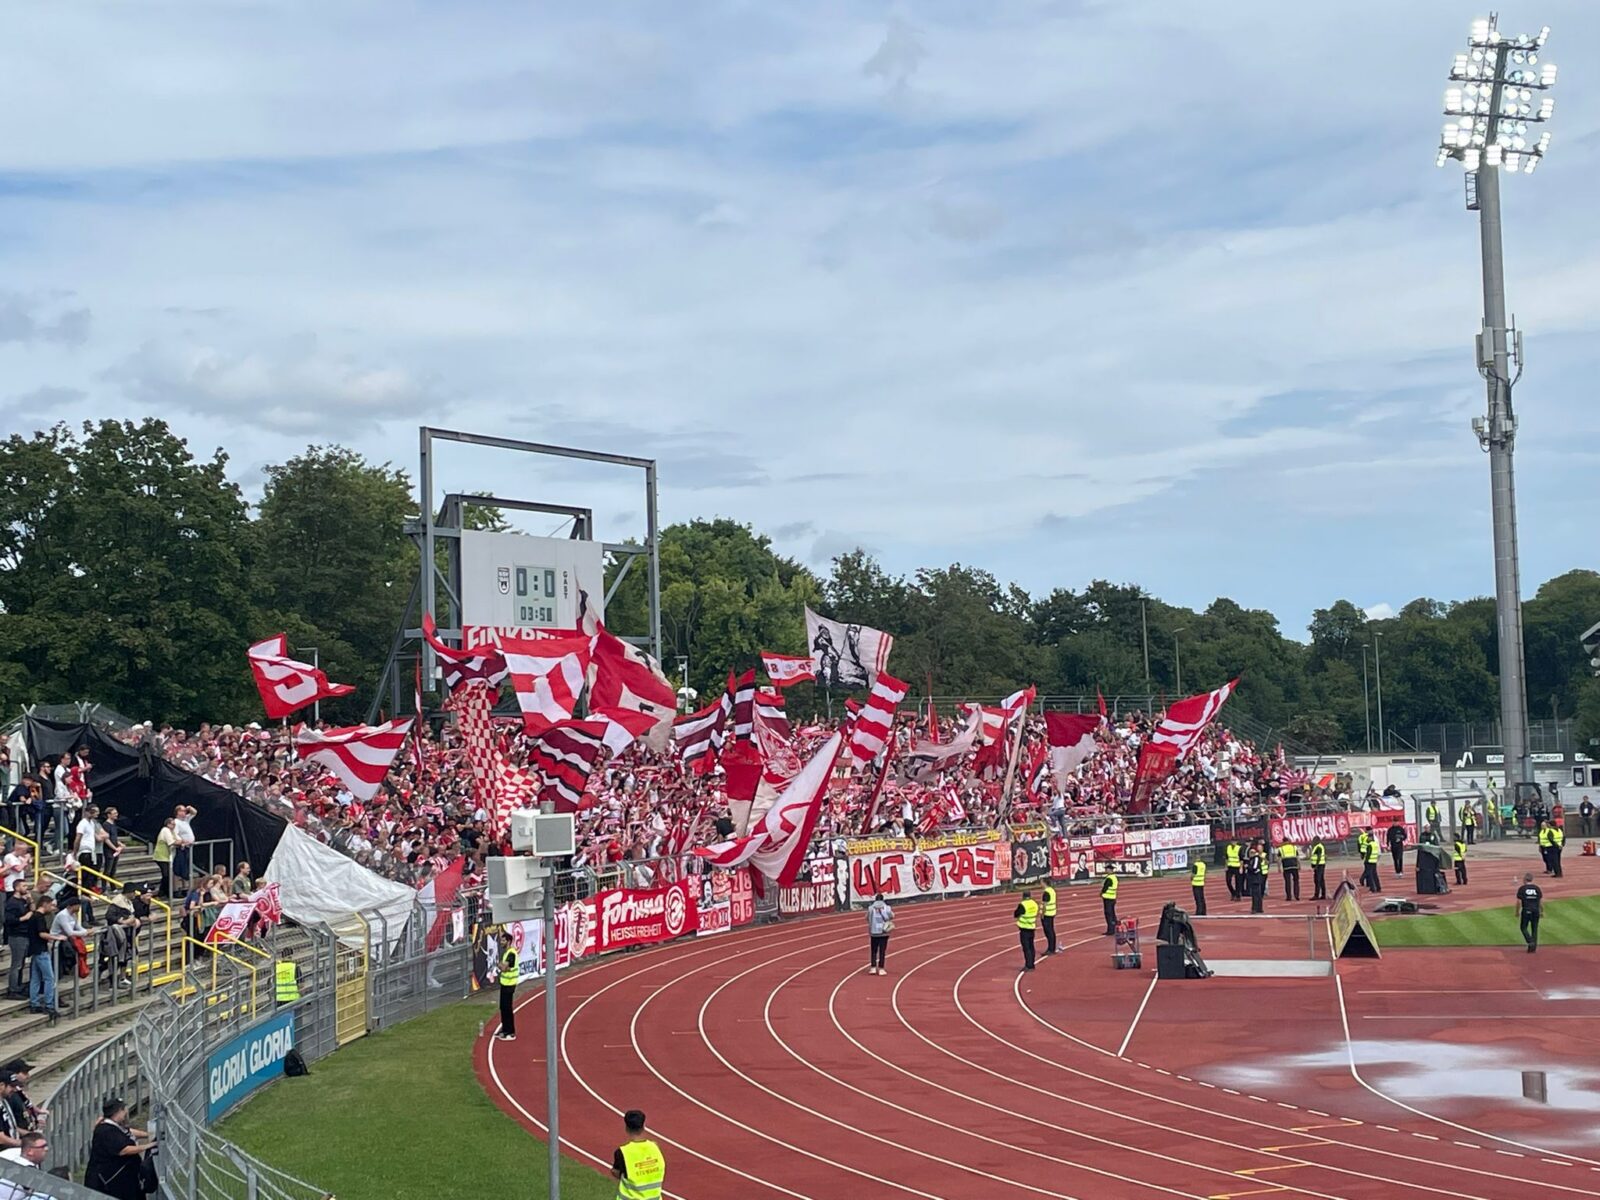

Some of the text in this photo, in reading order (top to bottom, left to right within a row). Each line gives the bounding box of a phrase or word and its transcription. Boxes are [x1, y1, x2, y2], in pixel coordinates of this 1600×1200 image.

[516, 567, 555, 598] 0:0
[1282, 816, 1338, 842] RATINGEN
[779, 882, 836, 912] ALLES AUS LIEBE
[602, 891, 665, 947] Fortuna
